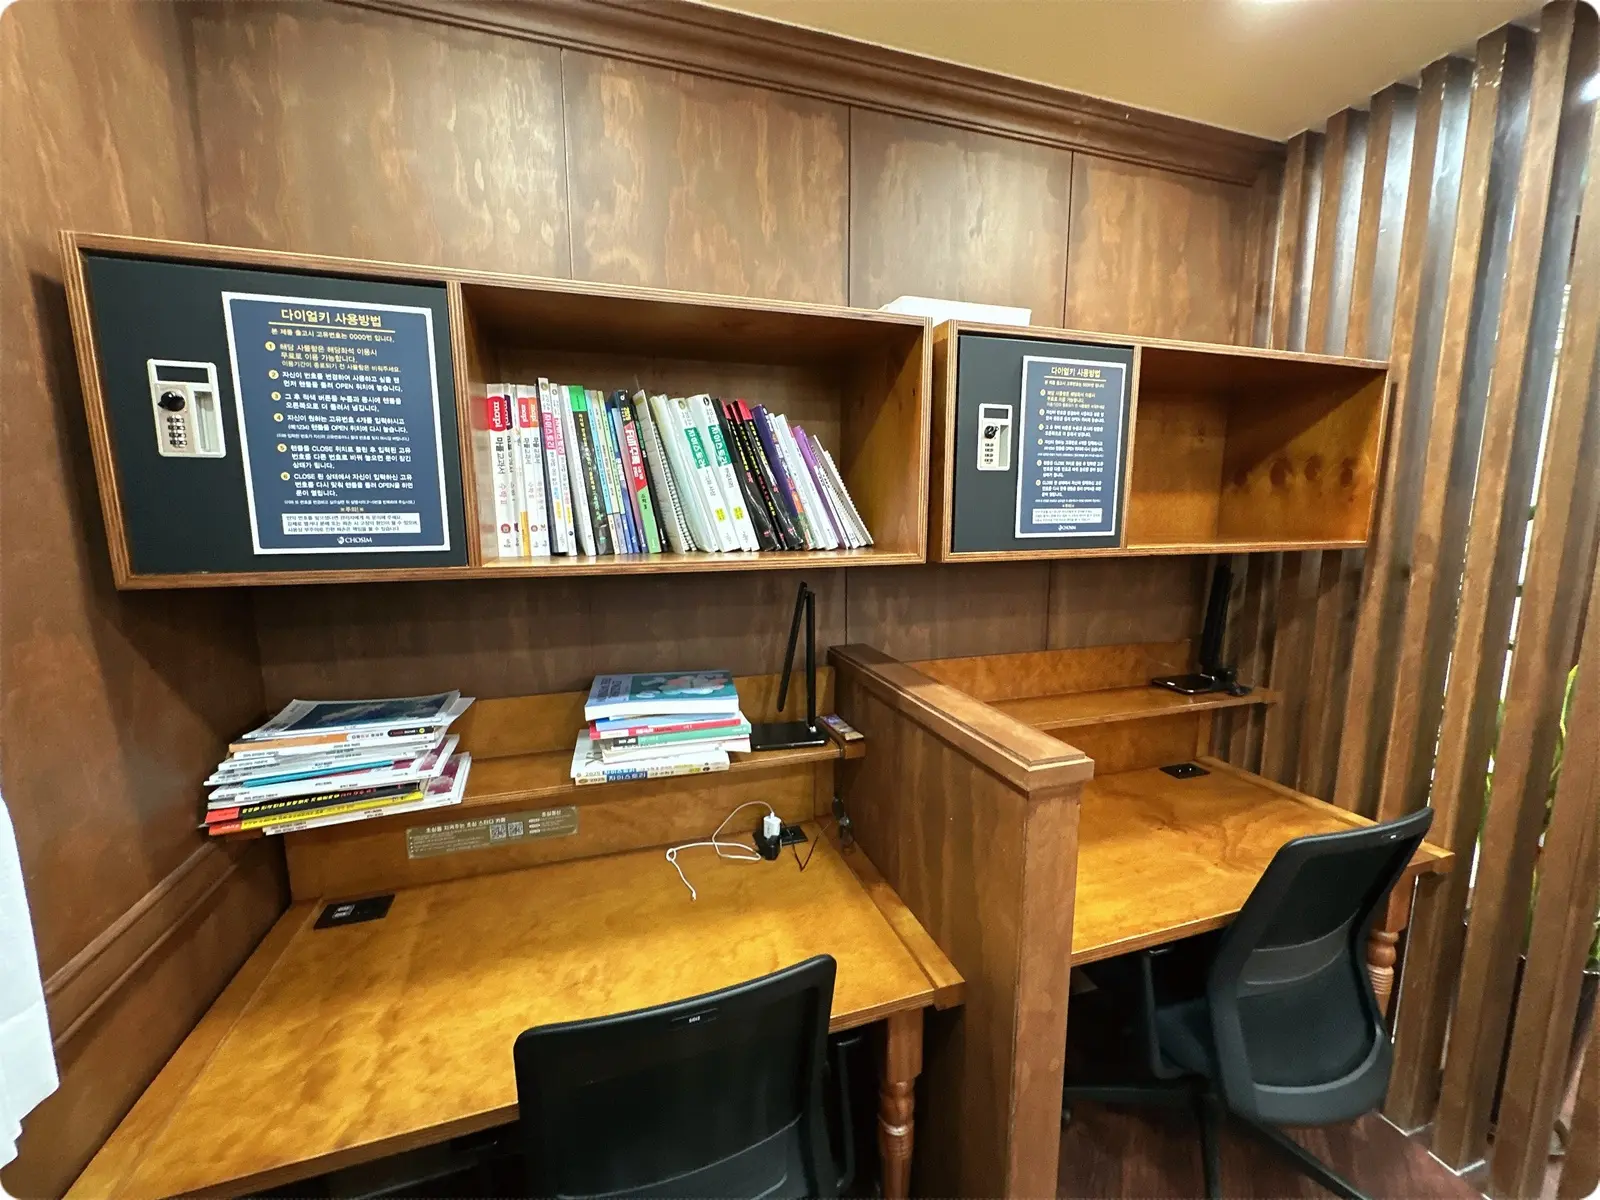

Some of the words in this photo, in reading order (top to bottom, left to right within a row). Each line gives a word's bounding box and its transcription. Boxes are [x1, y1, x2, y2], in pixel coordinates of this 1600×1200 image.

[281, 308, 330, 323] 다이얼키
[334, 312, 382, 327] 사용방법
[316, 330, 347, 339] 고유번호는
[374, 334, 394, 342] 입니다.
[280, 351, 302, 359] 무료로
[321, 354, 357, 362] 가능합니다.
[335, 382, 353, 390] OPEN
[328, 415, 354, 423] 고유번호
[492, 401, 503, 428] mapl
[520, 404, 529, 423] mapl
[529, 404, 537, 422] mapl
[543, 413, 556, 449] 자이스토리
[687, 428, 706, 468] 자이스토리
[711, 425, 729, 466] 자이스토리
[495, 436, 506, 475] 마플교과서
[608, 773, 646, 782] 자이스토리
